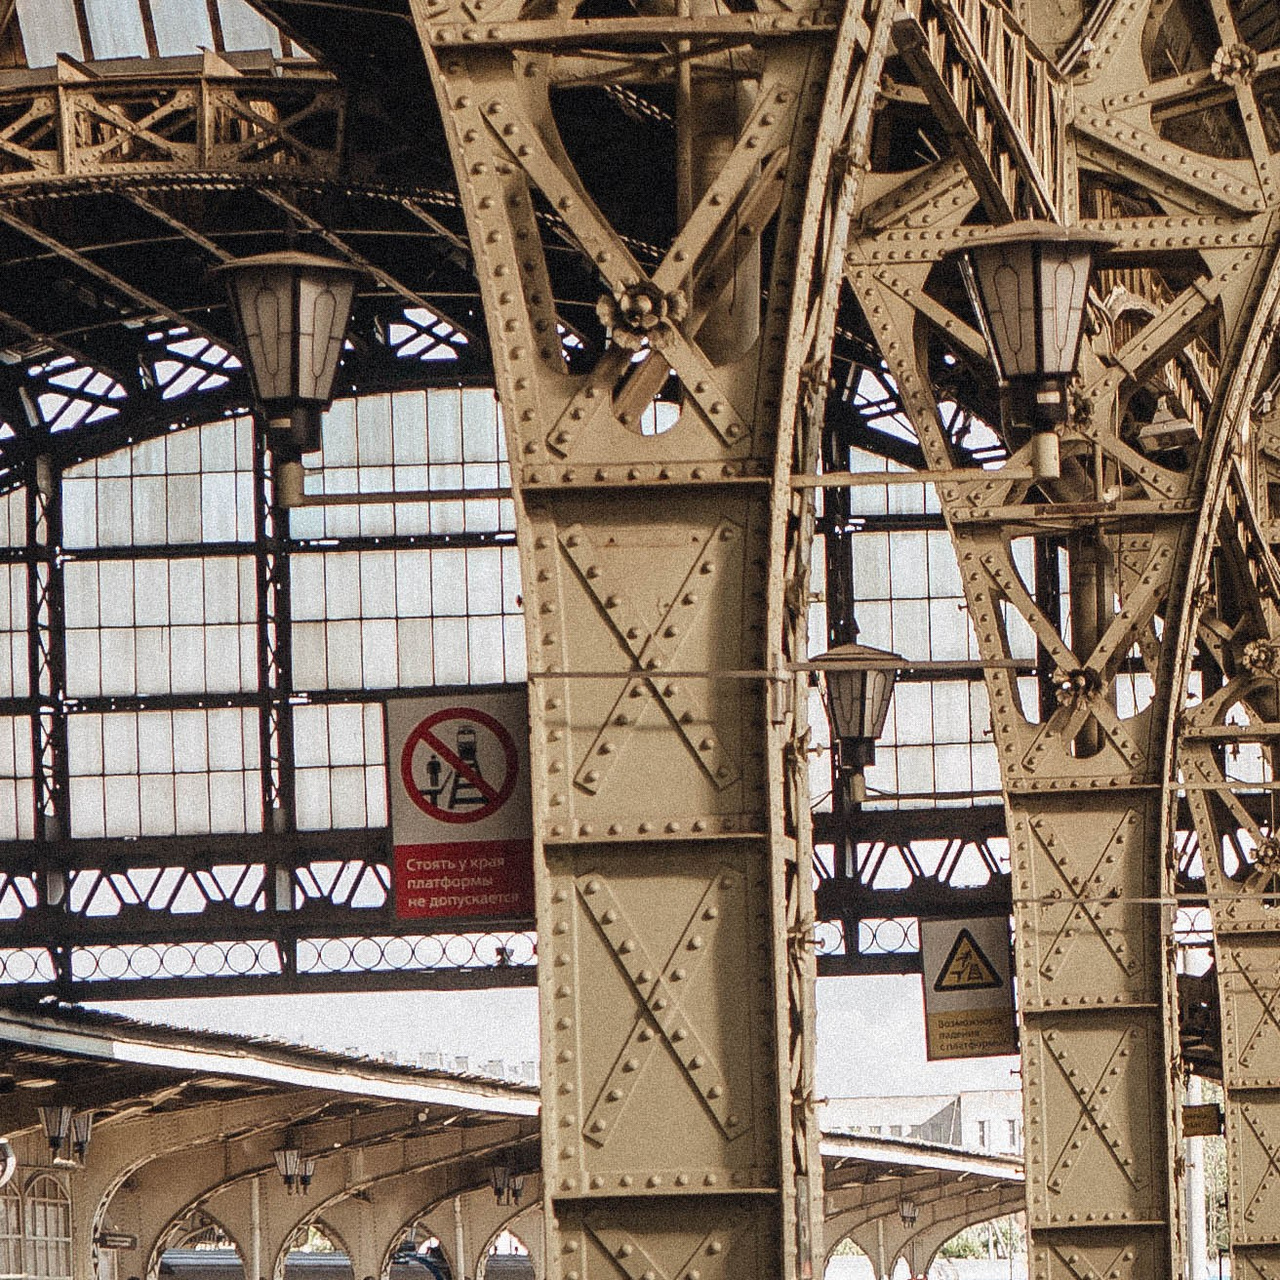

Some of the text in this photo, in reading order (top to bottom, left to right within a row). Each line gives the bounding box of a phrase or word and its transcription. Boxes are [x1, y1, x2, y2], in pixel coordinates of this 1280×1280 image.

[406, 857, 505, 871] Стоять у края
[407, 876, 493, 890] платформы
[408, 893, 519, 908] не допускается
